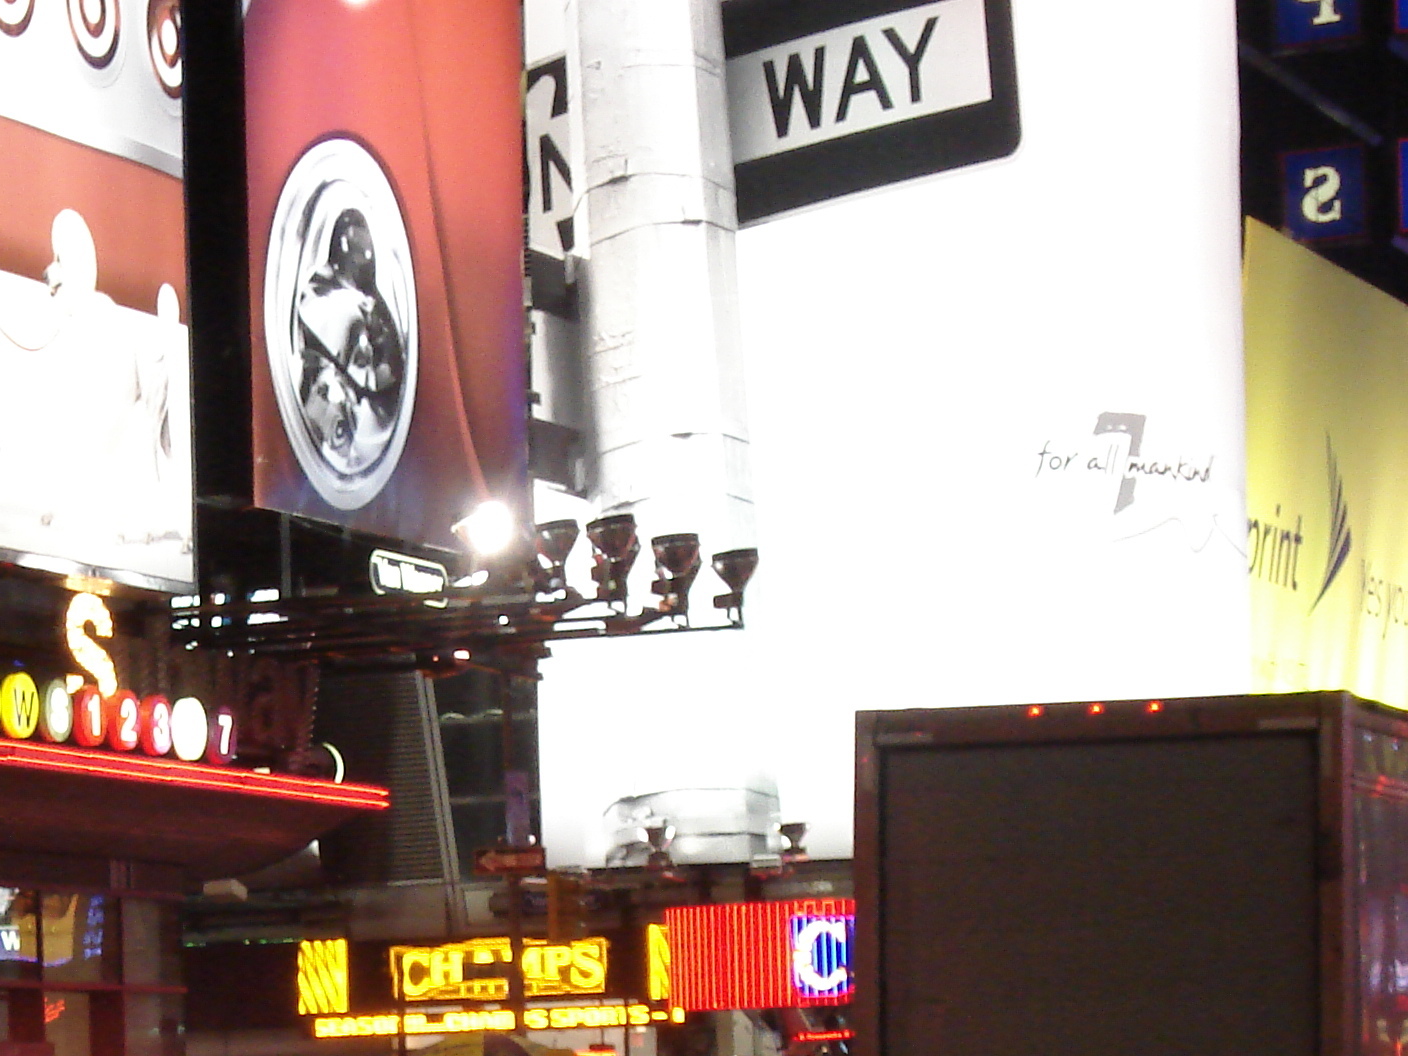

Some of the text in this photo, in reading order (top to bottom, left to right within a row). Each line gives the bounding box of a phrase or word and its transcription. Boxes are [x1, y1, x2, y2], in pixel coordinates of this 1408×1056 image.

[762, 15, 940, 139] WAY
[1036, 440, 1215, 483] for all mankind
[13, 688, 35, 728] W
[120, 698, 138, 743] 2
[153, 703, 170, 748] 3
[218, 714, 234, 755] 7
[550, 1005, 650, 1029] SPORTS
